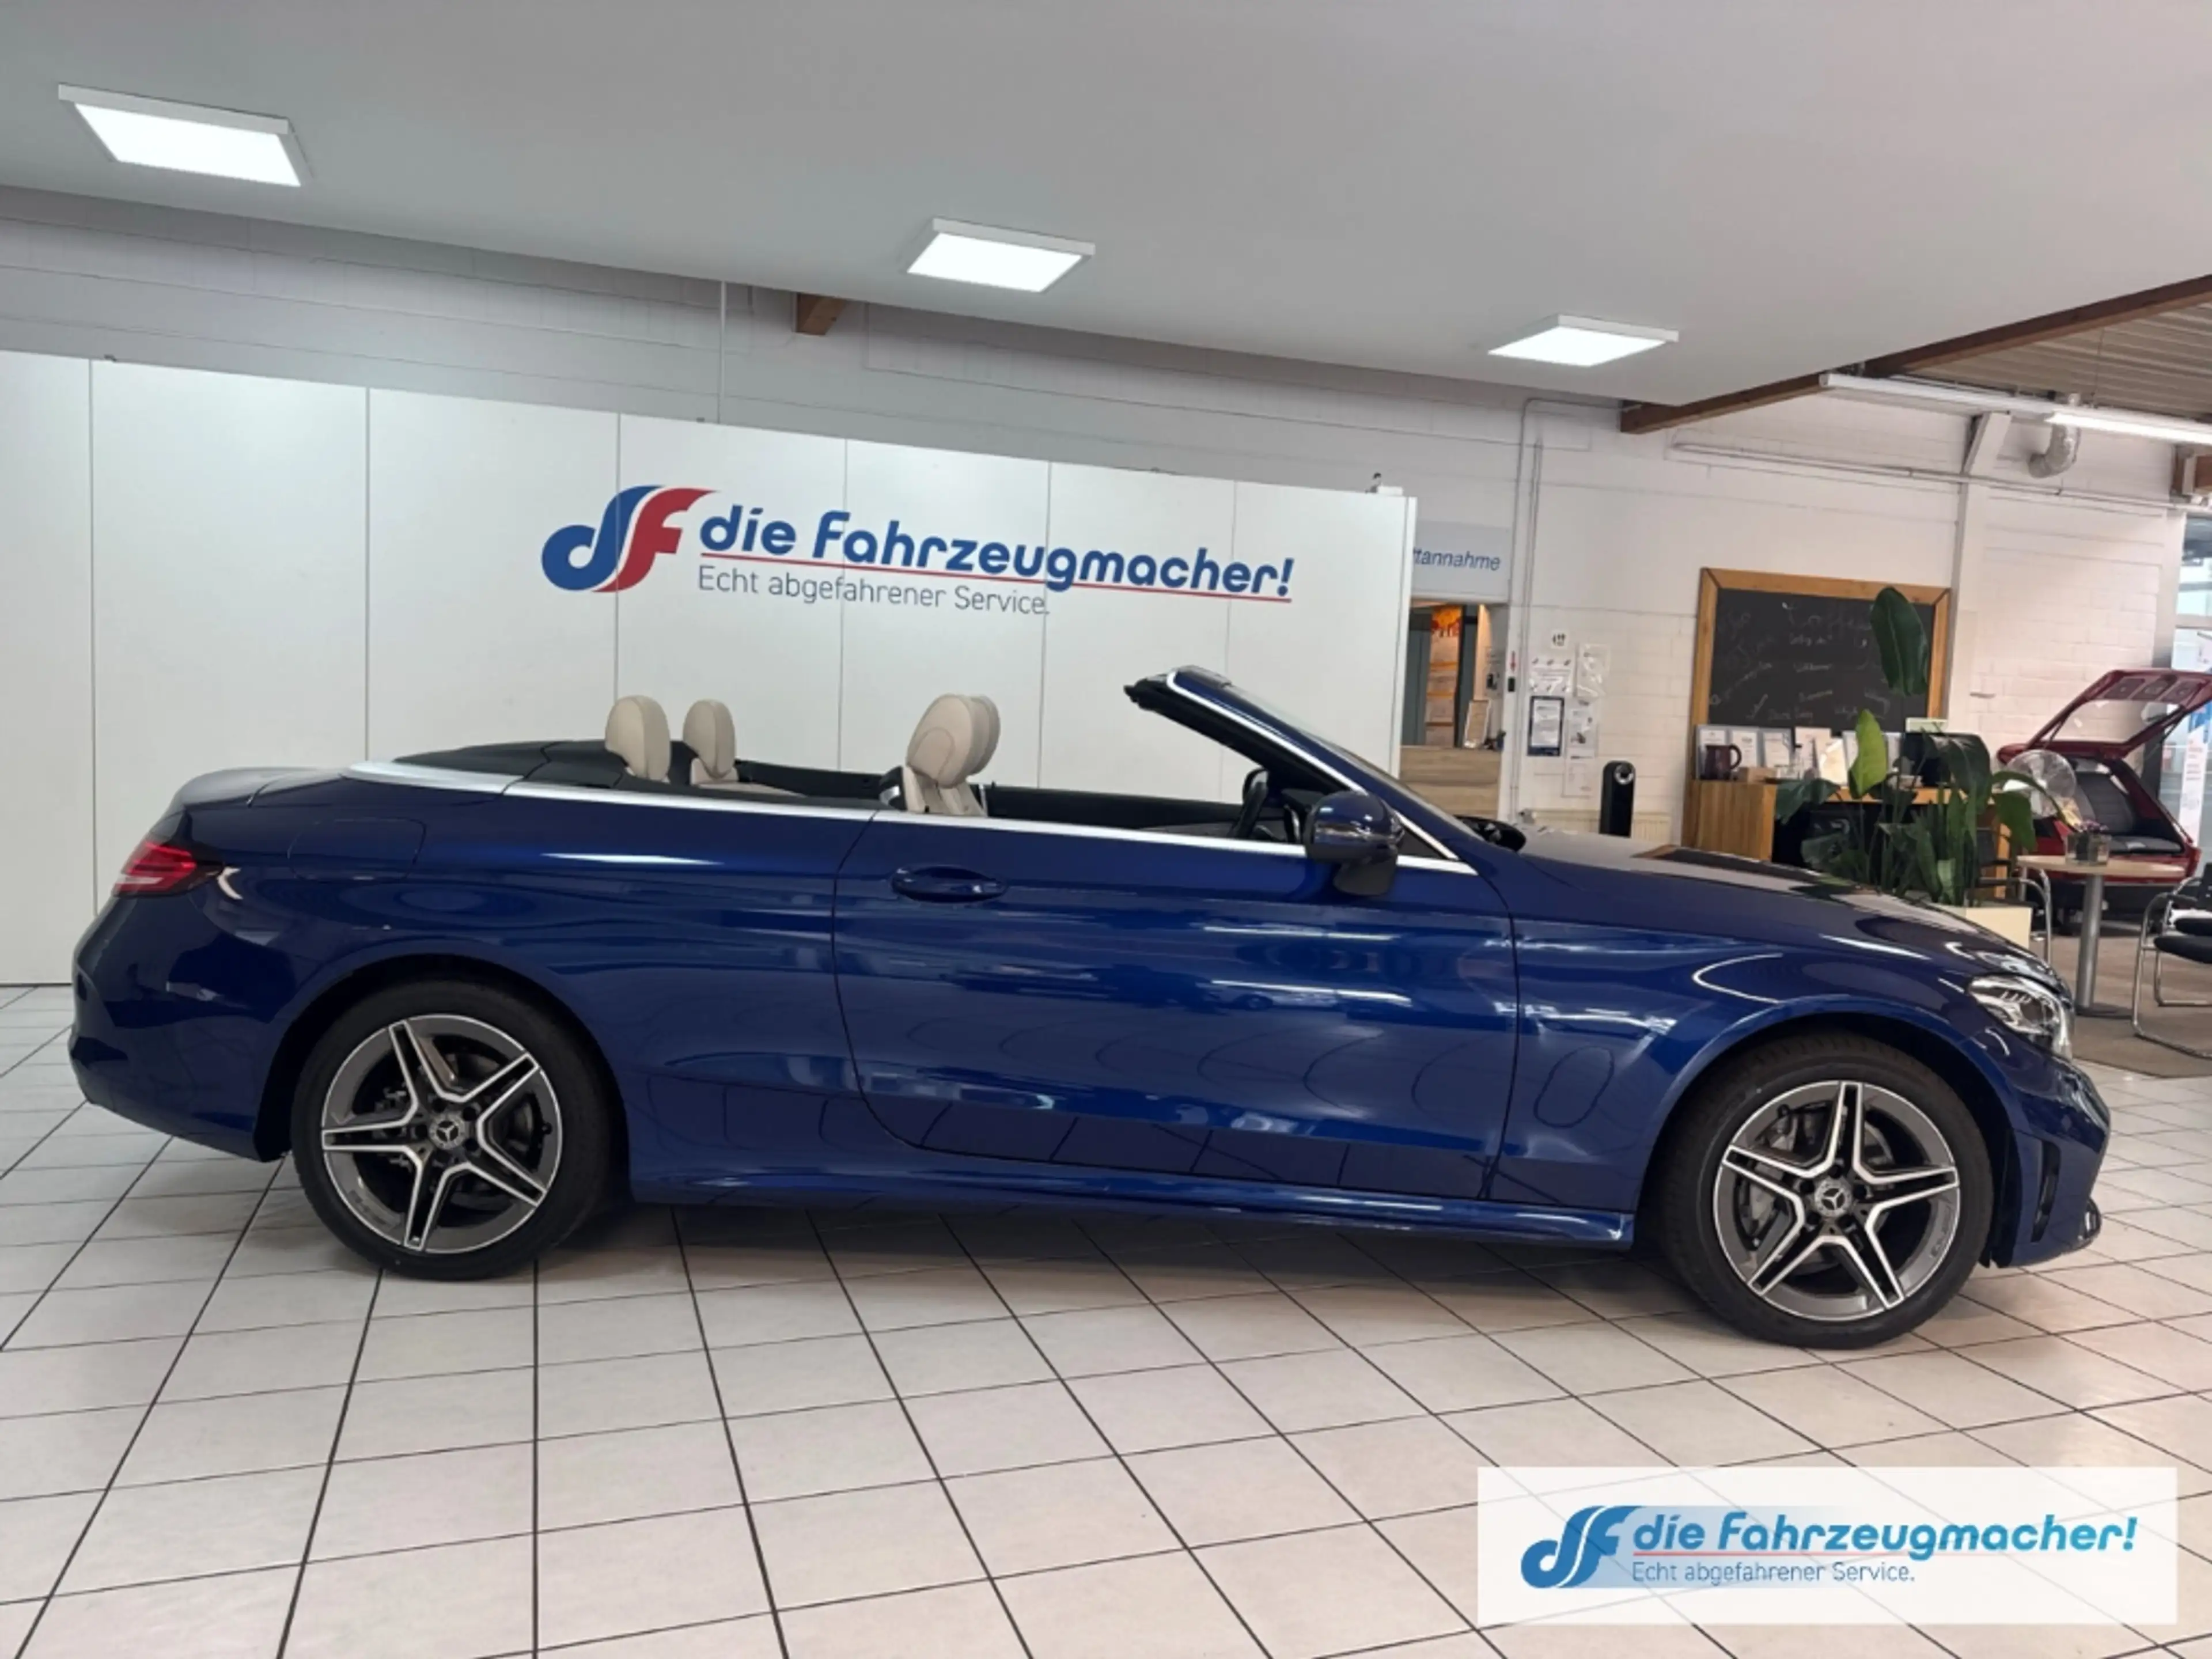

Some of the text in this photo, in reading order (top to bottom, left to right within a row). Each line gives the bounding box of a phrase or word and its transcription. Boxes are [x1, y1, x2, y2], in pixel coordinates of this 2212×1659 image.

[700, 503, 1294, 596] die Fahrzeugmacher!
[699, 565, 1050, 615] Echt abgefahrener Service.
